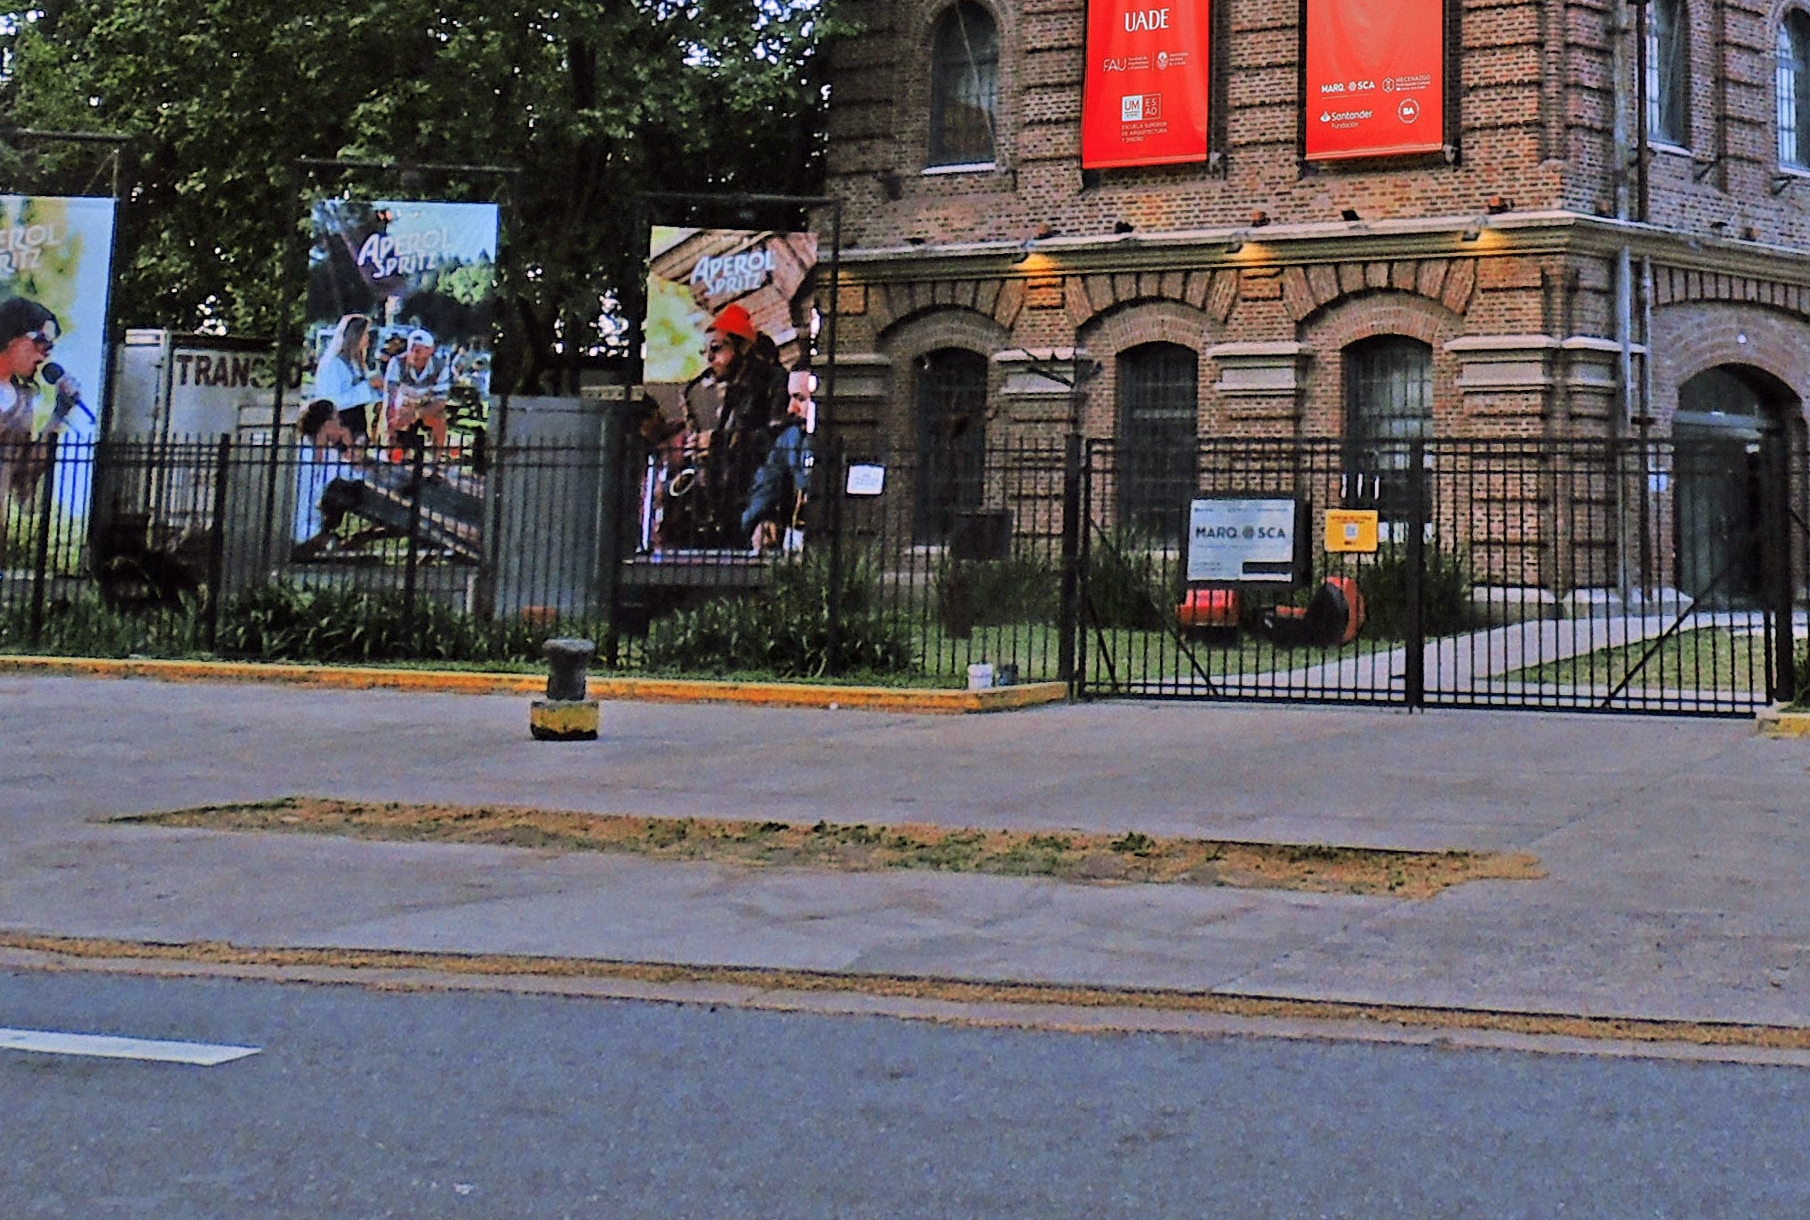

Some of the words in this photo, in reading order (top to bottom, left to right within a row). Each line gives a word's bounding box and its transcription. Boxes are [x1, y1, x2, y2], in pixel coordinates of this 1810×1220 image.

[1124, 8, 1170, 32] UADE
[1103, 57, 1127, 72] FAU
[1357, 80, 1376, 90] SCA
[1124, 99, 1140, 111] UM
[1331, 110, 1373, 123] Santander
[357, 226, 453, 267] APEROL
[372, 251, 438, 279] SPRITZ
[690, 248, 778, 286] APEROL
[704, 270, 762, 297] SPRITZ
[1257, 526, 1286, 539] SCA
